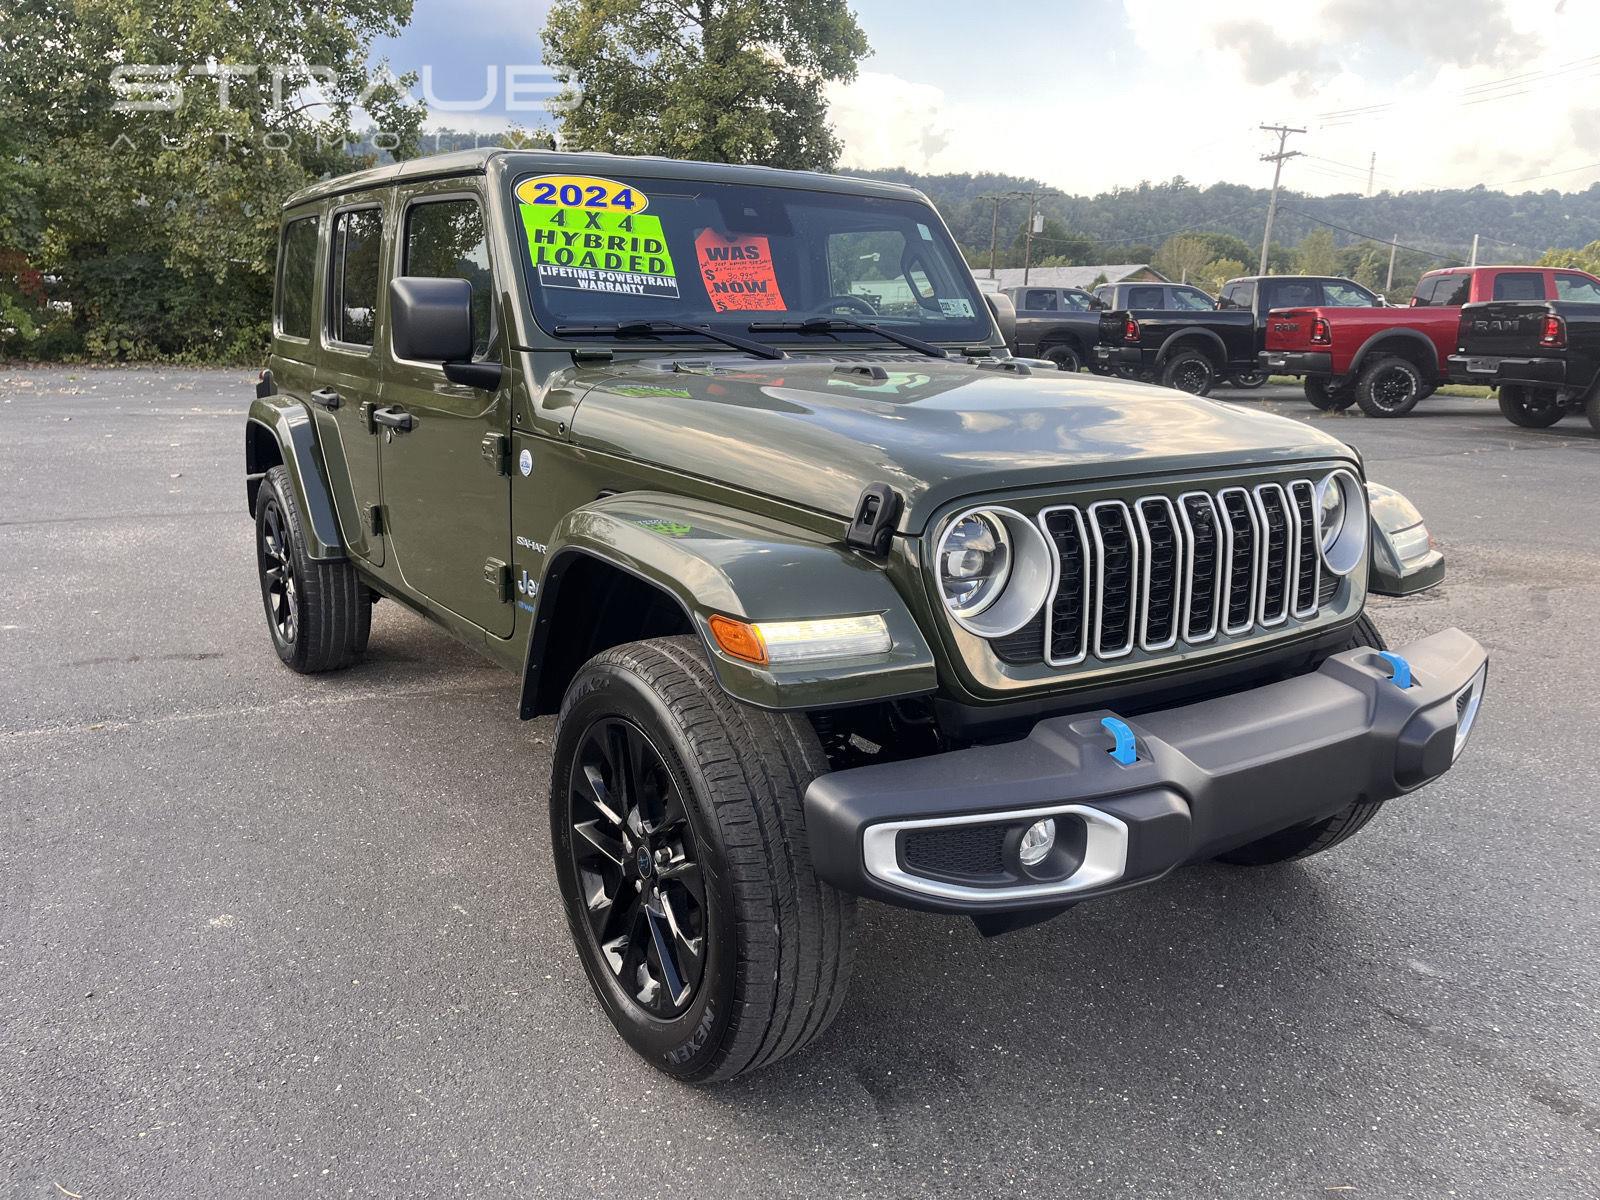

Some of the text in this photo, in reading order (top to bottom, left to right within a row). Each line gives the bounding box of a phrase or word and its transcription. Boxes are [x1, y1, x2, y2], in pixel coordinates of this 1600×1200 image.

[533, 183, 635, 210] 2024
[534, 229, 664, 254] HYBRID
[536, 247, 666, 274] LOADED
[705, 245, 760, 261] WAS
[540, 266, 676, 288] LIFETIME POWERTRAIN
[577, 279, 644, 295] WARRANTY
[713, 281, 767, 293] NOW
[1273, 323, 1299, 332] RAM
[1474, 320, 1519, 331] RAM
[516, 535, 547, 554] SAHAR
